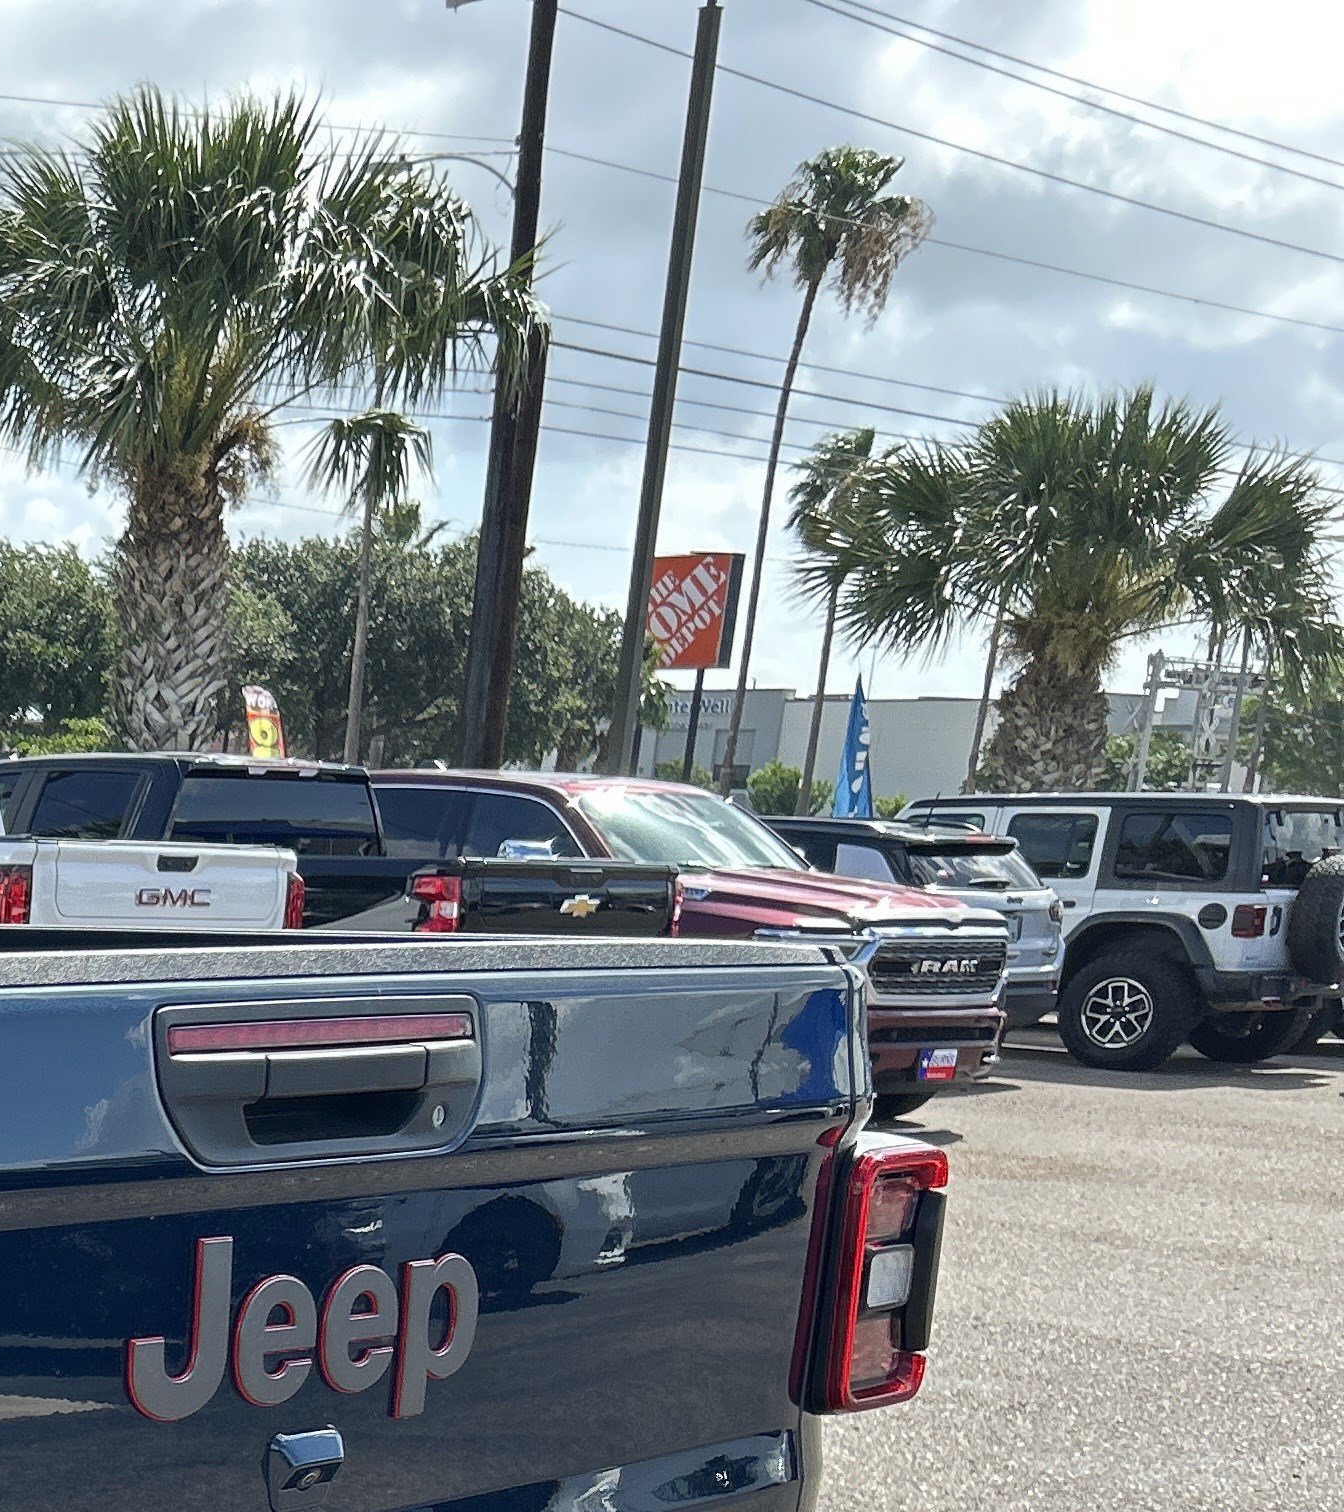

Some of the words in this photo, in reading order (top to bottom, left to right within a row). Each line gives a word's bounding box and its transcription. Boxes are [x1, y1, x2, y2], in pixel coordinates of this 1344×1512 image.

[647, 556, 727, 641] OME
[649, 569, 680, 605] HE
[659, 595, 723, 668] DEPOT
[135, 887, 212, 908] GMC
[917, 958, 979, 975] RAM
[123, 1235, 480, 1422] Jeep
